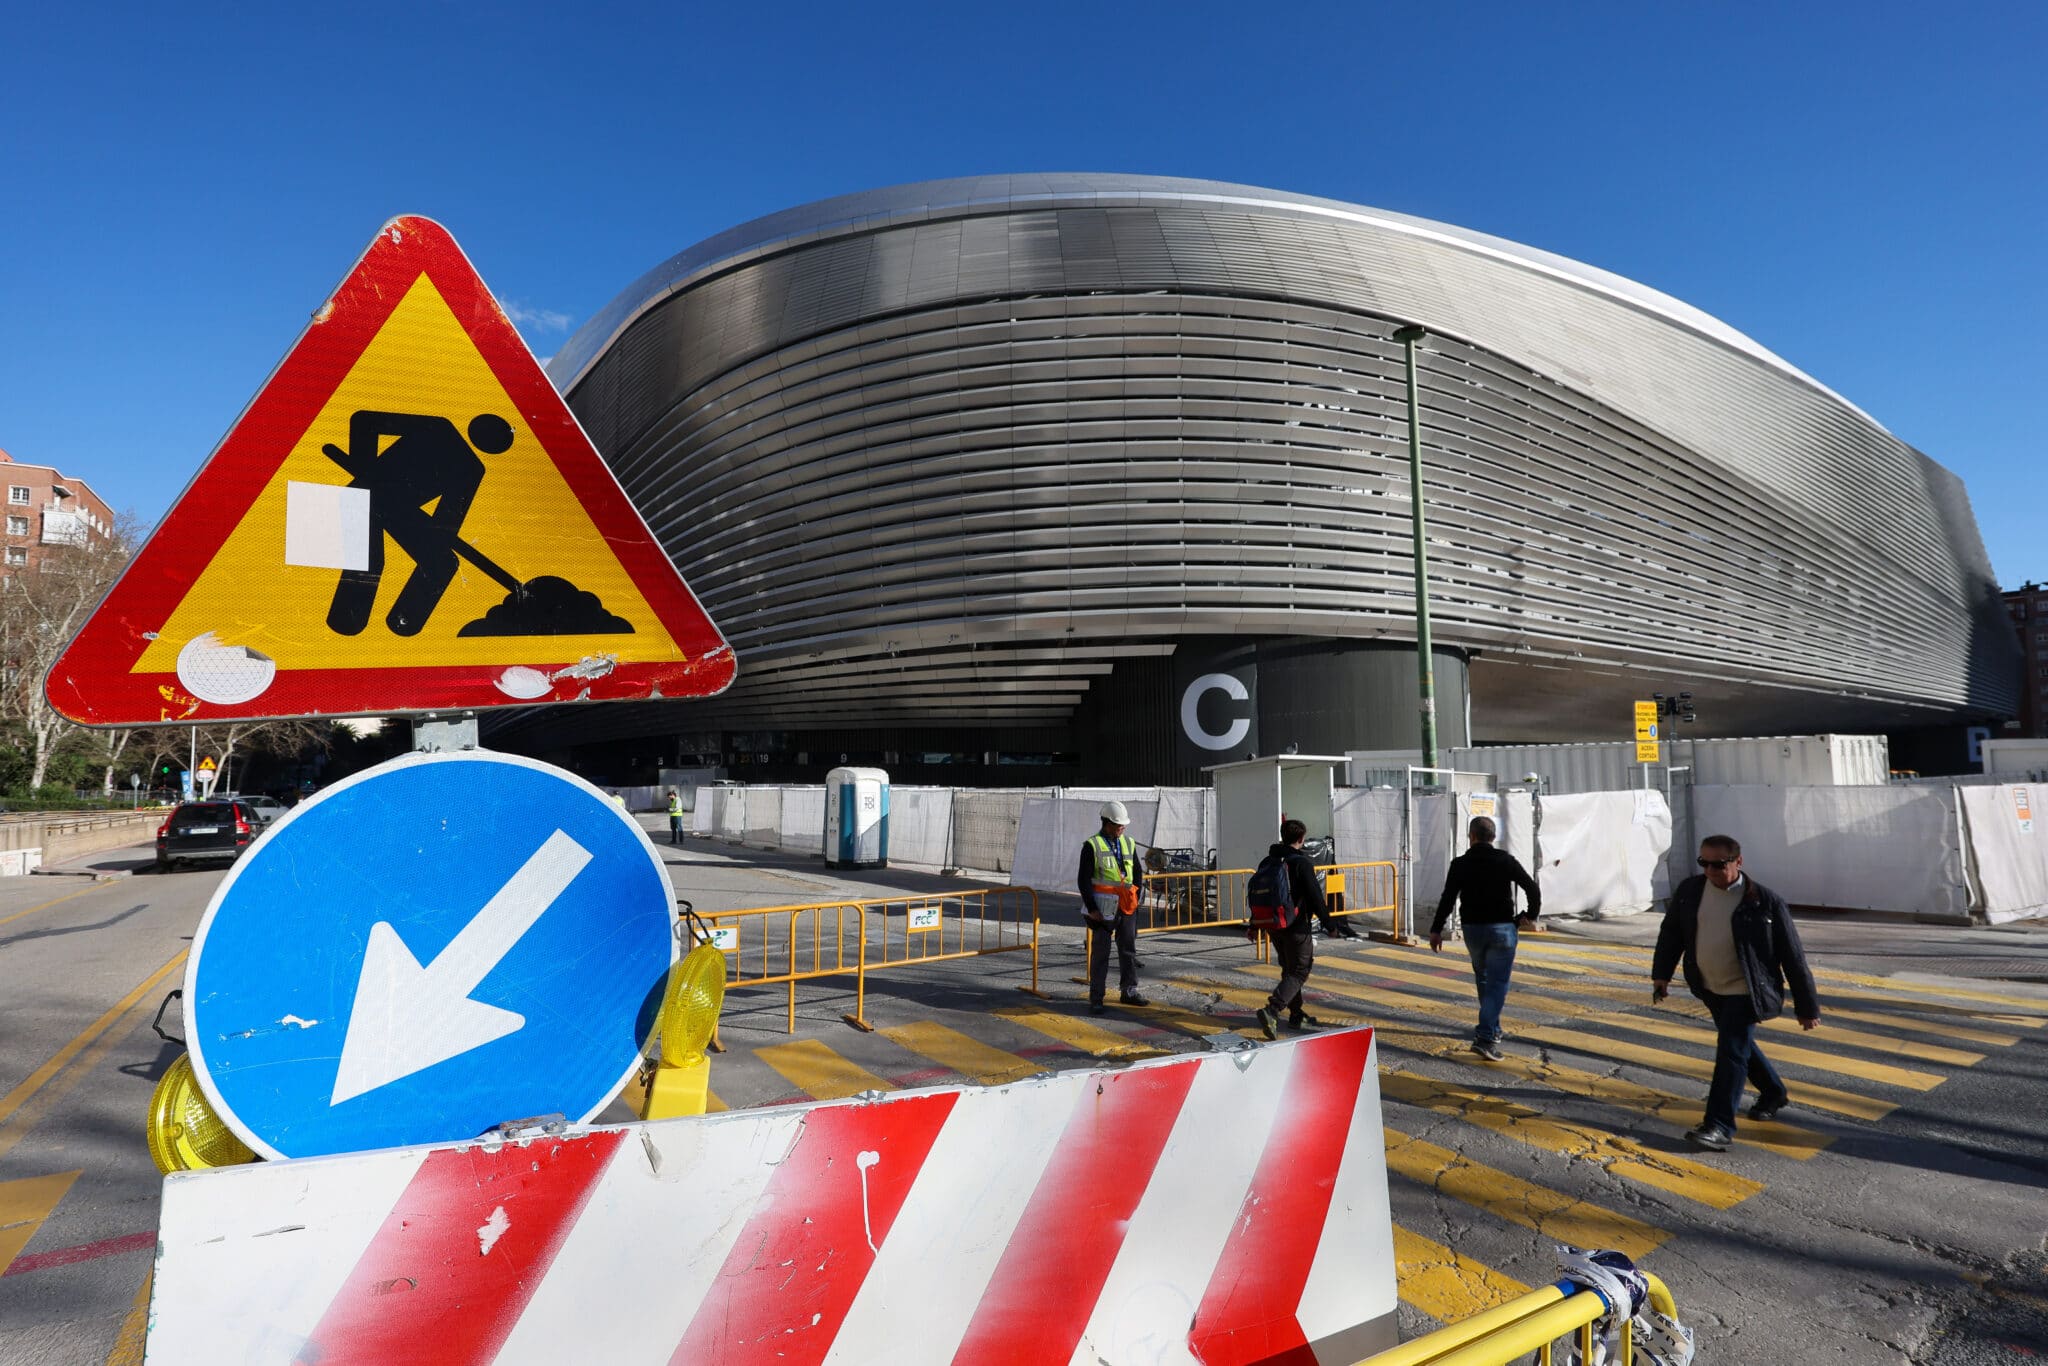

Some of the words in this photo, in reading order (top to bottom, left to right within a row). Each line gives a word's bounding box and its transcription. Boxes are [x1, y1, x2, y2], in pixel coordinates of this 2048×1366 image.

[1181, 673, 1250, 750] C
[759, 753, 769, 763] 19
[840, 753, 848, 763] 9
[915, 915, 932, 925] FCC
